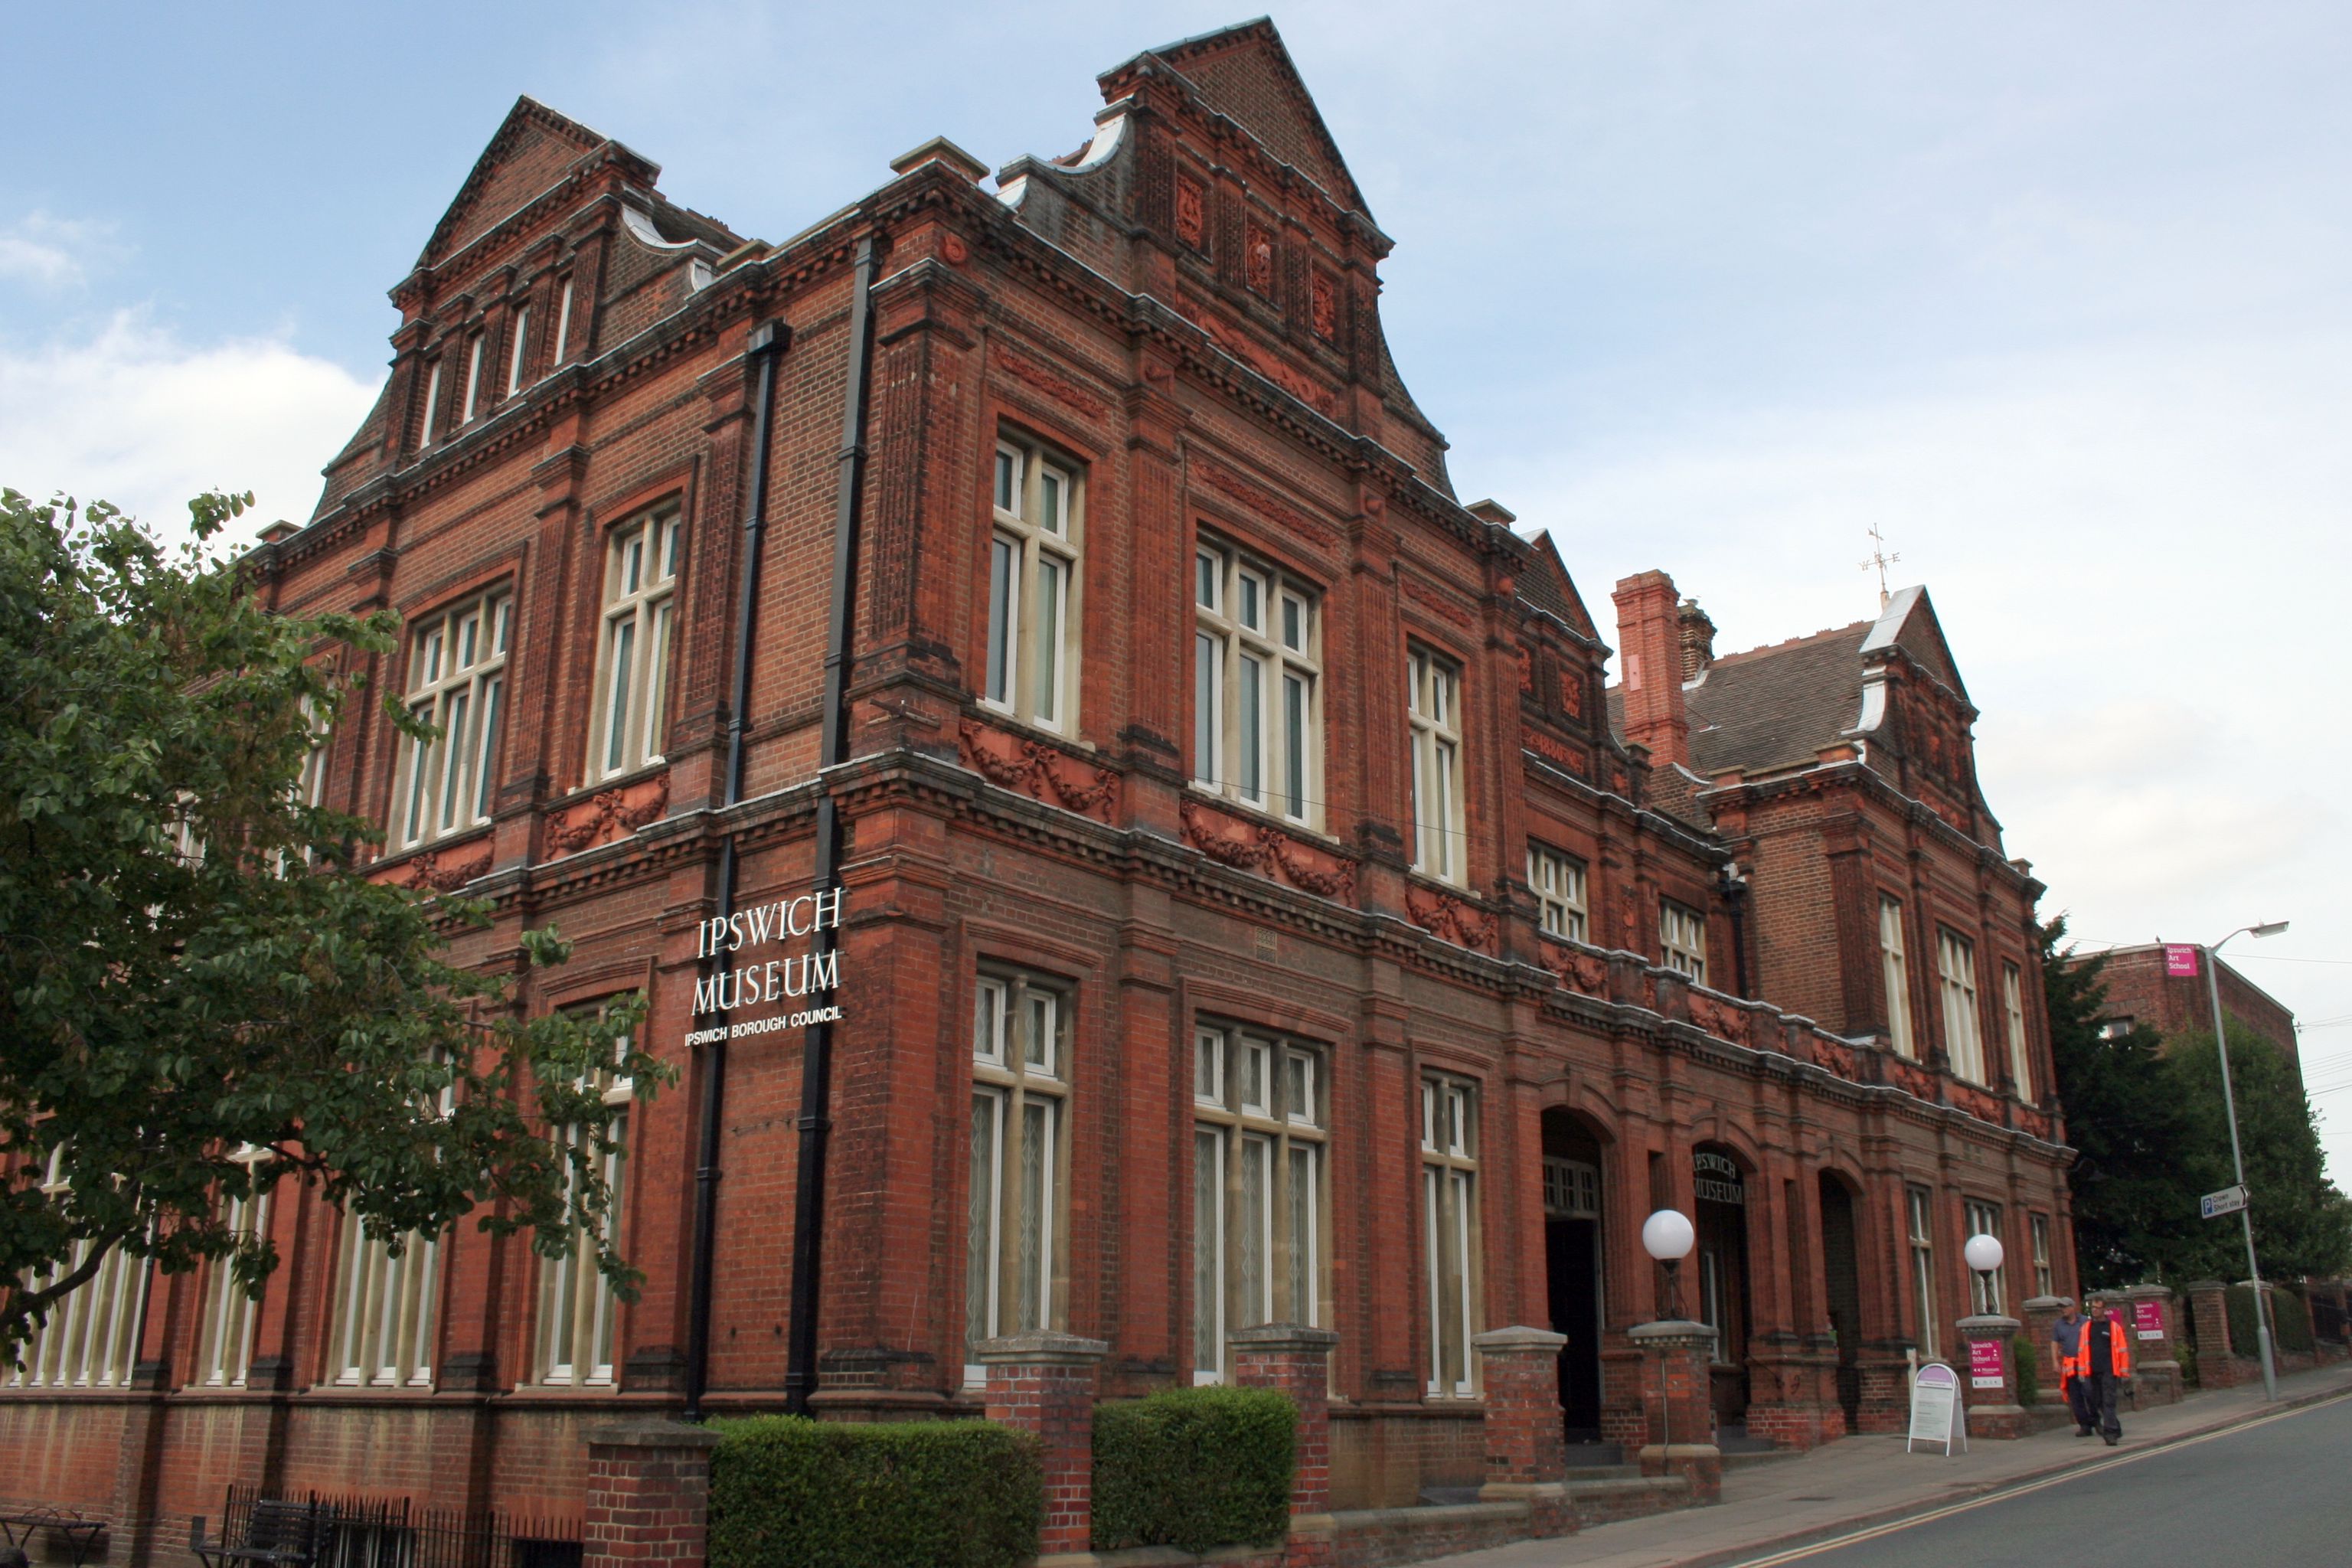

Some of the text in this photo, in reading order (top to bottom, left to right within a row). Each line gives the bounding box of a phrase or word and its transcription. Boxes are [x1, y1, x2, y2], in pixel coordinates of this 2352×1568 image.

[697, 887, 841, 959] IPSWICH
[691, 949, 838, 1016] MUSEUM
[684, 1005, 841, 1047] IPSWICH BOROUGH COUNCIL
[1692, 1153, 1736, 1179] IPSWICH
